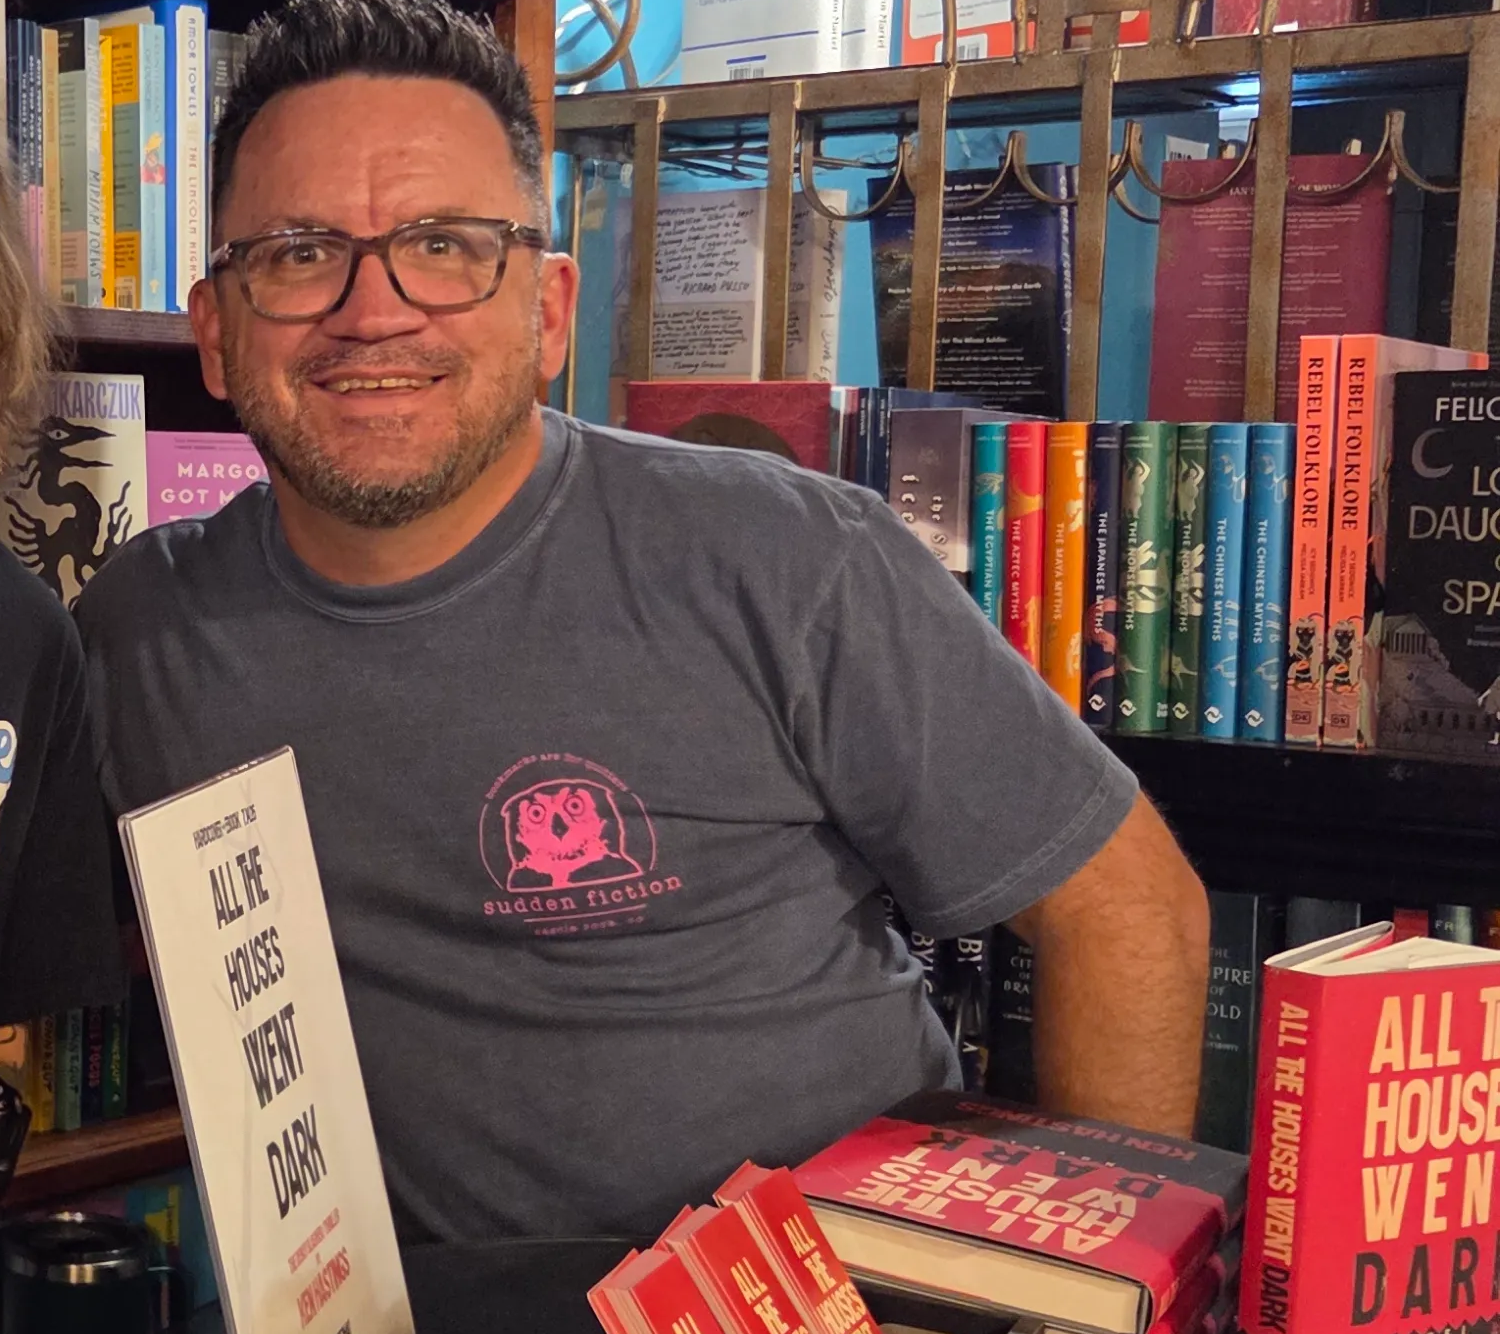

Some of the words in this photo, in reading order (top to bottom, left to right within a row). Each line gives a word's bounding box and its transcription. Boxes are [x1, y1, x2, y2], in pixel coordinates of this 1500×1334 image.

[188, 17, 197, 59] AMOR
[188, 66, 198, 118] TOWLES
[189, 146, 197, 168] THE
[189, 176, 198, 235] LINCOLN
[189, 241, 198, 282] HIGHW
[51, 380, 142, 420] KARCZUK
[1304, 357, 1324, 420] REBEL
[160, 488, 210, 505] GOT
[1301, 424, 1323, 529] FOLKLORE
[1011, 519, 1021, 542] THE
[1098, 512, 1108, 534] THE
[1128, 521, 1138, 546] THE
[1216, 518, 1228, 543] THE
[1010, 544, 1021, 578] AZTEC
[1095, 536, 1107, 594] JAPANESE
[1126, 547, 1138, 588] NORSE
[1214, 545, 1227, 597] CHINESE
[1010, 581, 1020, 620] MYTHS
[1093, 596, 1104, 635] MYTHS
[1125, 591, 1136, 631] MYTHS
[1211, 600, 1224, 642] MYTHS
[209, 861, 245, 930] ALL
[235, 844, 271, 912] THE
[483, 895, 577, 916] sudden
[586, 874, 683, 908] fiction
[224, 925, 286, 1012] HOUSES
[1212, 967, 1253, 986] PIRE
[1206, 1001, 1242, 1021] OLD
[1277, 1001, 1309, 1049] ALL
[1369, 992, 1460, 1074] ALL
[241, 1001, 305, 1110] WENT
[1273, 1053, 1306, 1098] THE
[266, 1104, 328, 1220] DARK
[1267, 1100, 1303, 1194] HOUSES
[878, 1161, 1132, 1239] HOUSES
[891, 1147, 1138, 1219] WENT
[1261, 1196, 1297, 1266] WENT
